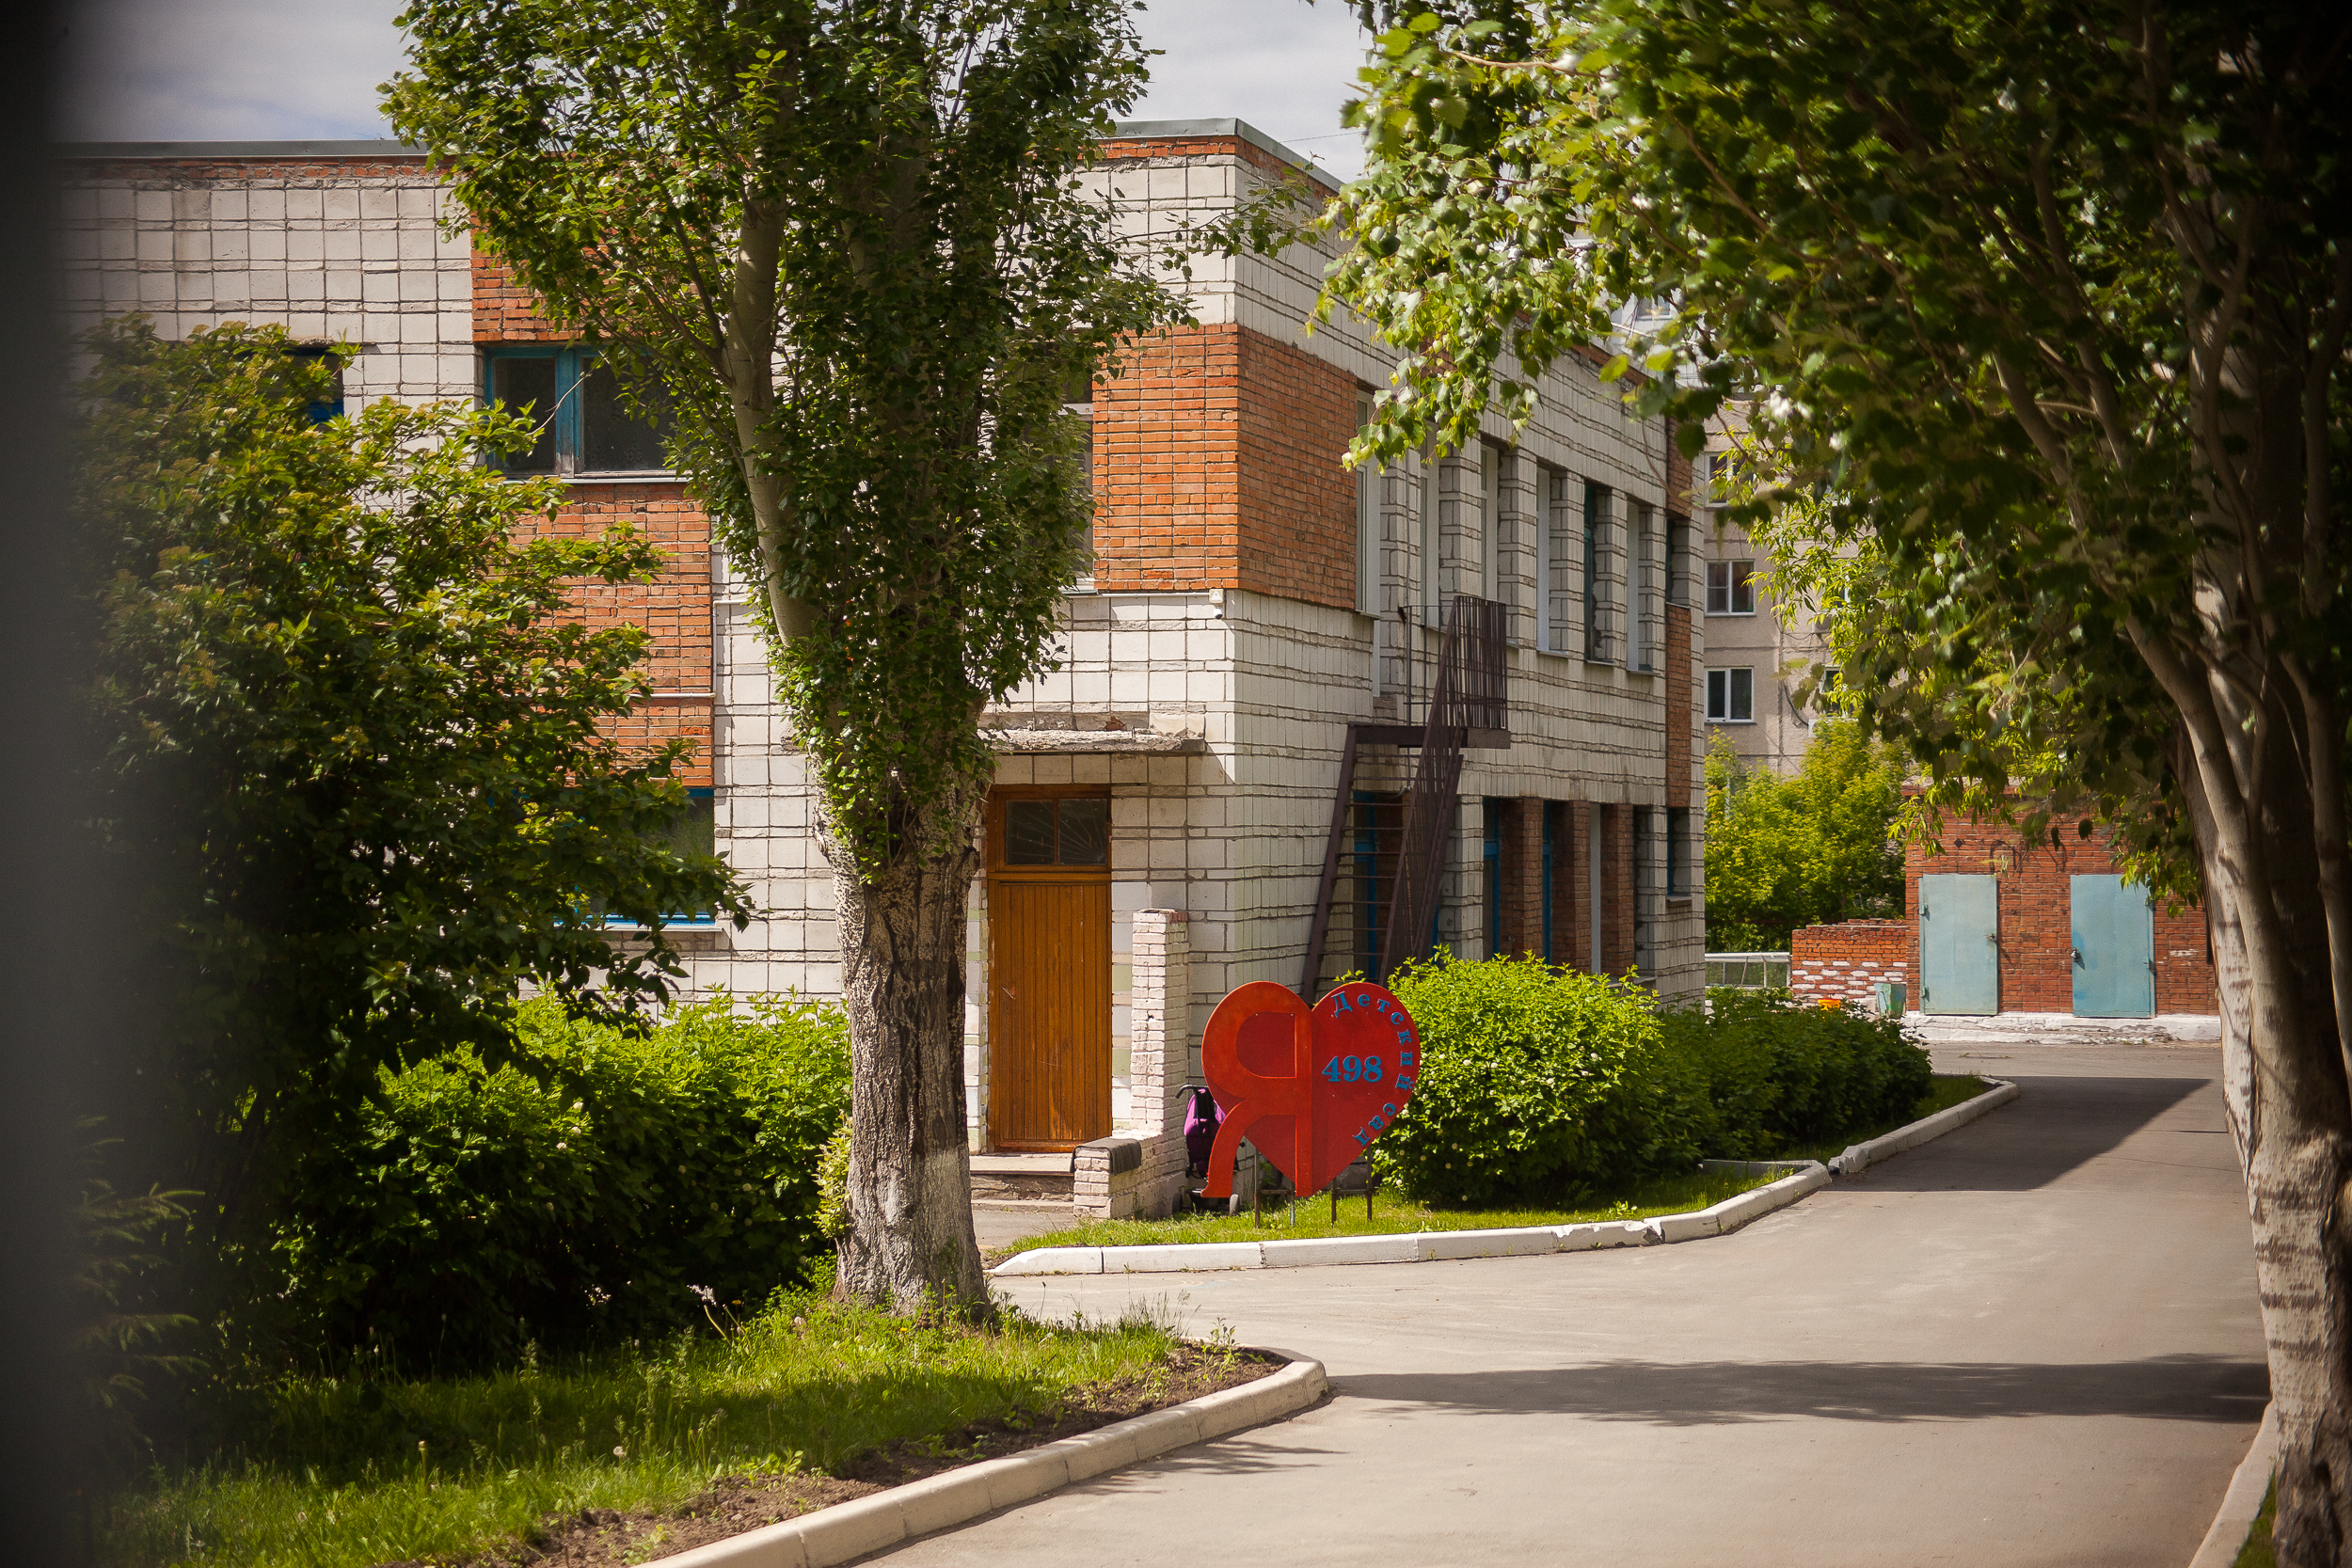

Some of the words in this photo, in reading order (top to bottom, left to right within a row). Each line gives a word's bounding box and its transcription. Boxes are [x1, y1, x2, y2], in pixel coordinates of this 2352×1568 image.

[1331, 990, 1415, 1091] Детский
[1321, 1055, 1383, 1083] 498
[1352, 1102, 1396, 1147] сад
